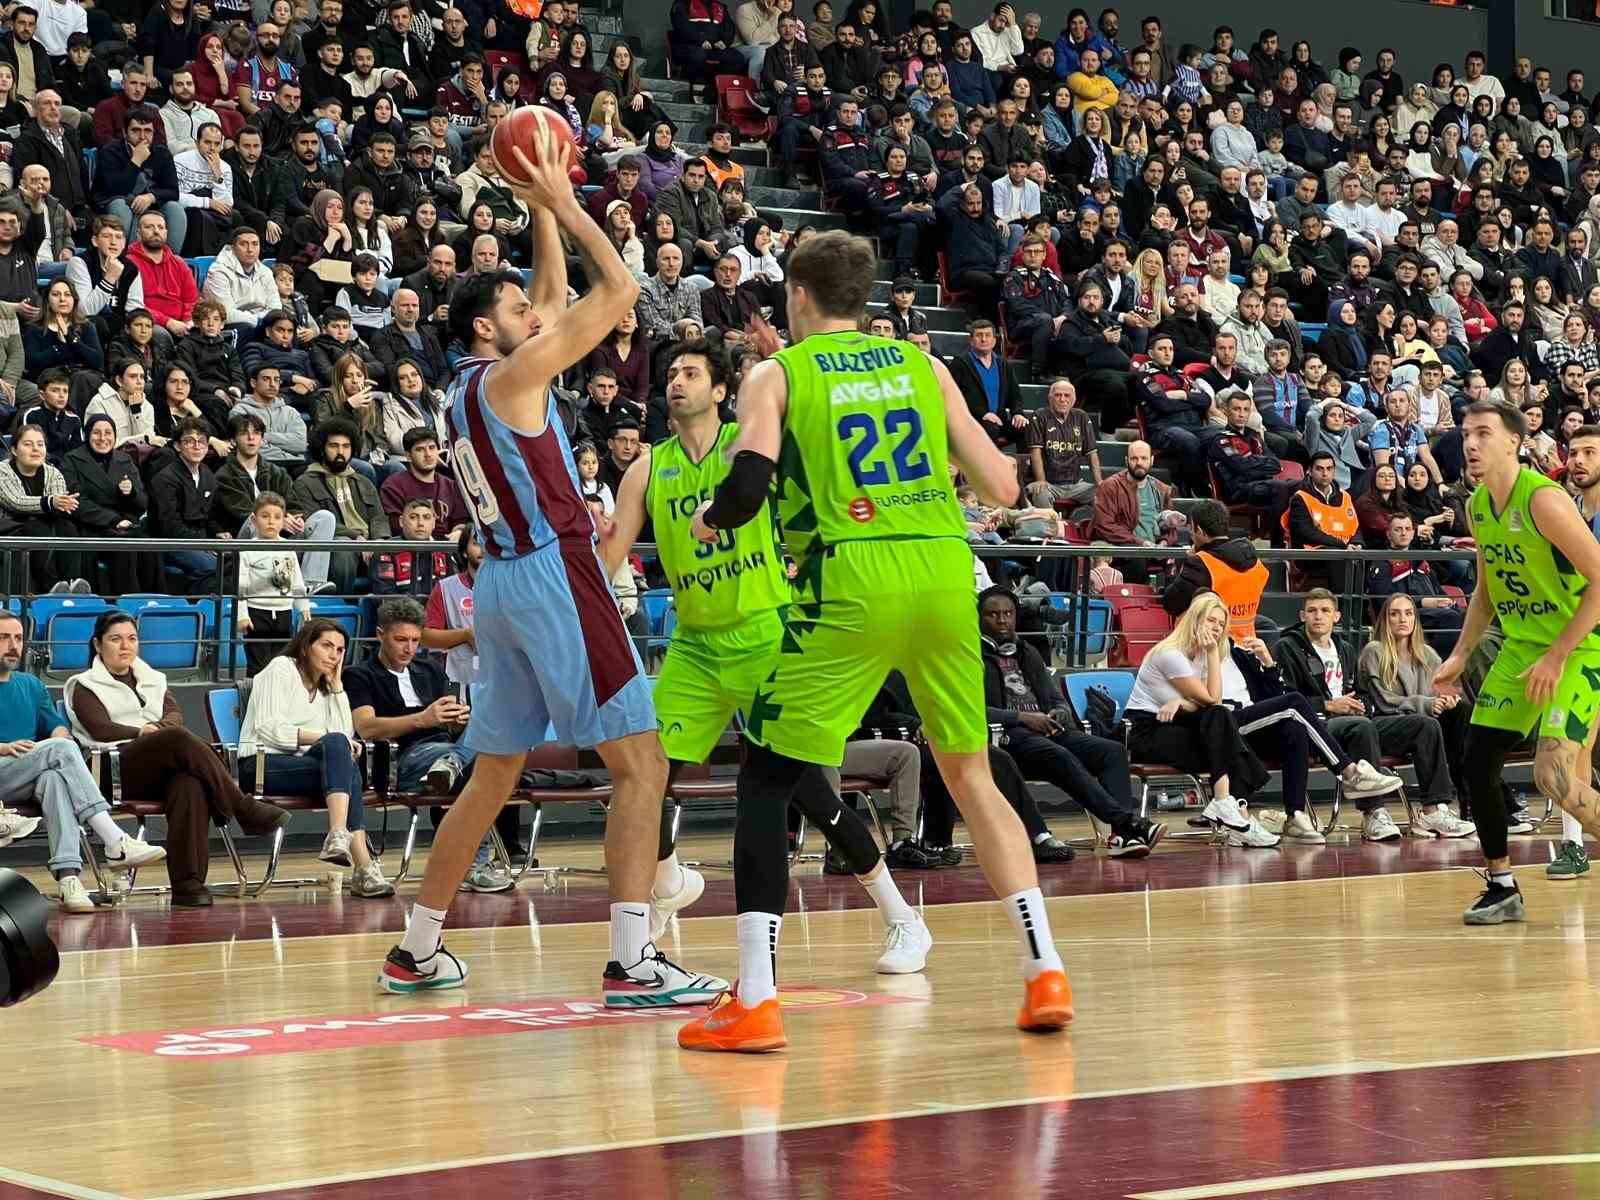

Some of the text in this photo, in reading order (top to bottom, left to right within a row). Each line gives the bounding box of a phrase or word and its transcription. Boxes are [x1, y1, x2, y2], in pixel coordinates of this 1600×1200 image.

[814, 346, 904, 373] BLAZEVIC
[830, 375, 914, 405] AYGAZ
[837, 407, 932, 488] 22
[451, 436, 499, 525] 9
[666, 486, 718, 522] TOF
